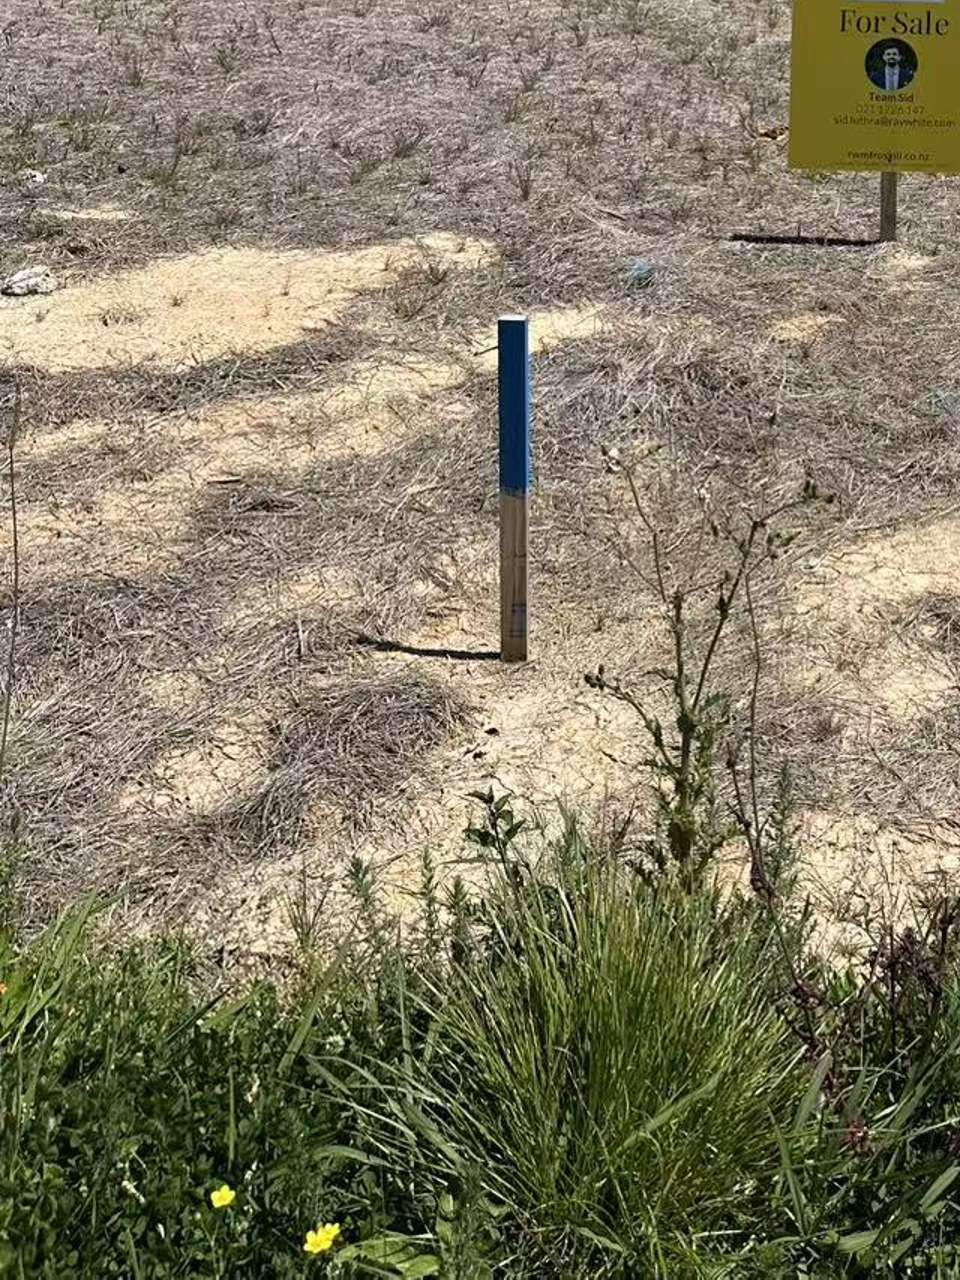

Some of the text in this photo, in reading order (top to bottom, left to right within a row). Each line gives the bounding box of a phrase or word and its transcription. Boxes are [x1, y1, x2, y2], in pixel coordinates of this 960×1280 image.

[840, 9, 949, 36] For Sale
[869, 92, 914, 103] Team Sid
